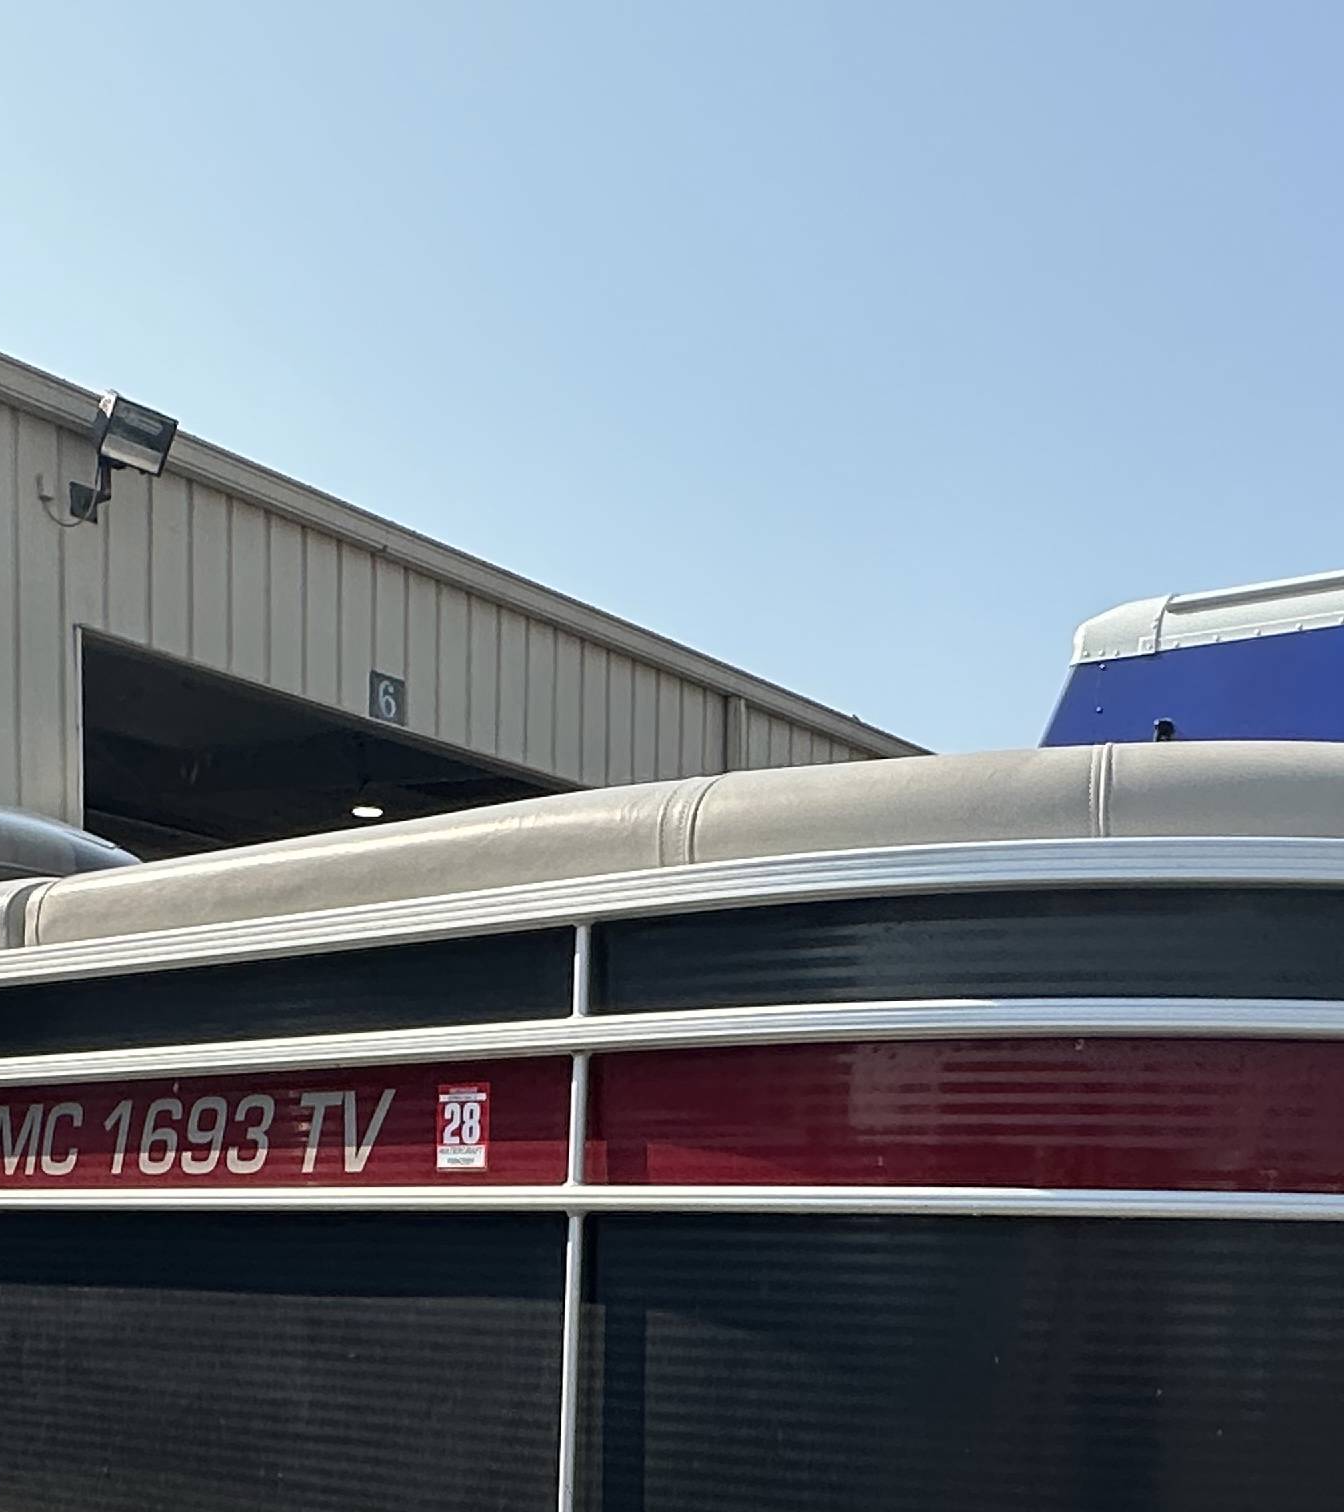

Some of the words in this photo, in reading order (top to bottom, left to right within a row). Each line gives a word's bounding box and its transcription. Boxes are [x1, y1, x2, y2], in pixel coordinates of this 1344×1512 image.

[379, 680, 396, 718] 6
[104, 1094, 274, 1175] 1693
[300, 1088, 396, 1173] TV
[442, 1102, 481, 1144] 28
